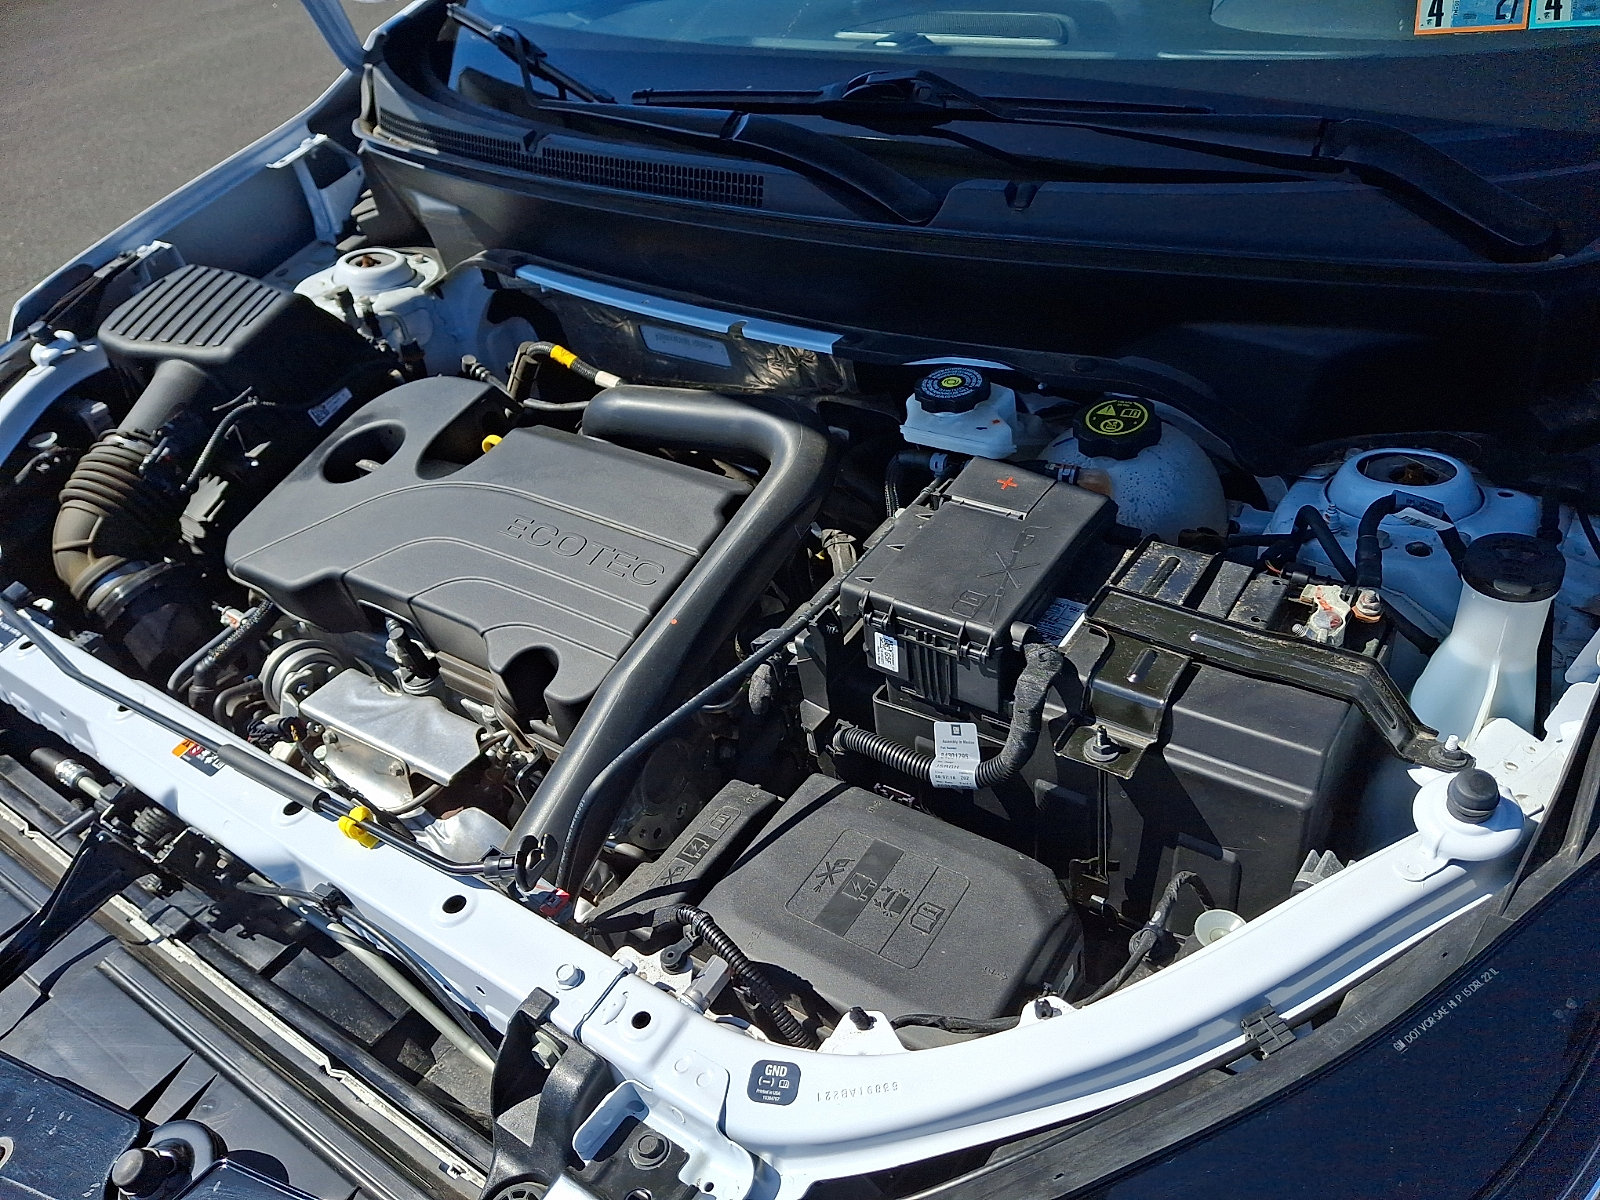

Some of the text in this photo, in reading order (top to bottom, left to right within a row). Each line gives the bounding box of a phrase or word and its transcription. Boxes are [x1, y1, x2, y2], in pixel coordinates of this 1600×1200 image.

[1428, 0, 1444, 27] 4
[1545, 0, 1563, 20] 4
[497, 514, 665, 586] ECOTEC
[1404, 1028, 1421, 1044] DOT
[1418, 1016, 1436, 1031] VOR
[1433, 1005, 1450, 1020] SAE
[1455, 994, 1462, 1003] P
[1468, 980, 1485, 993] DRL
[1481, 971, 1493, 982] 22
[765, 1064, 788, 1077] GND
